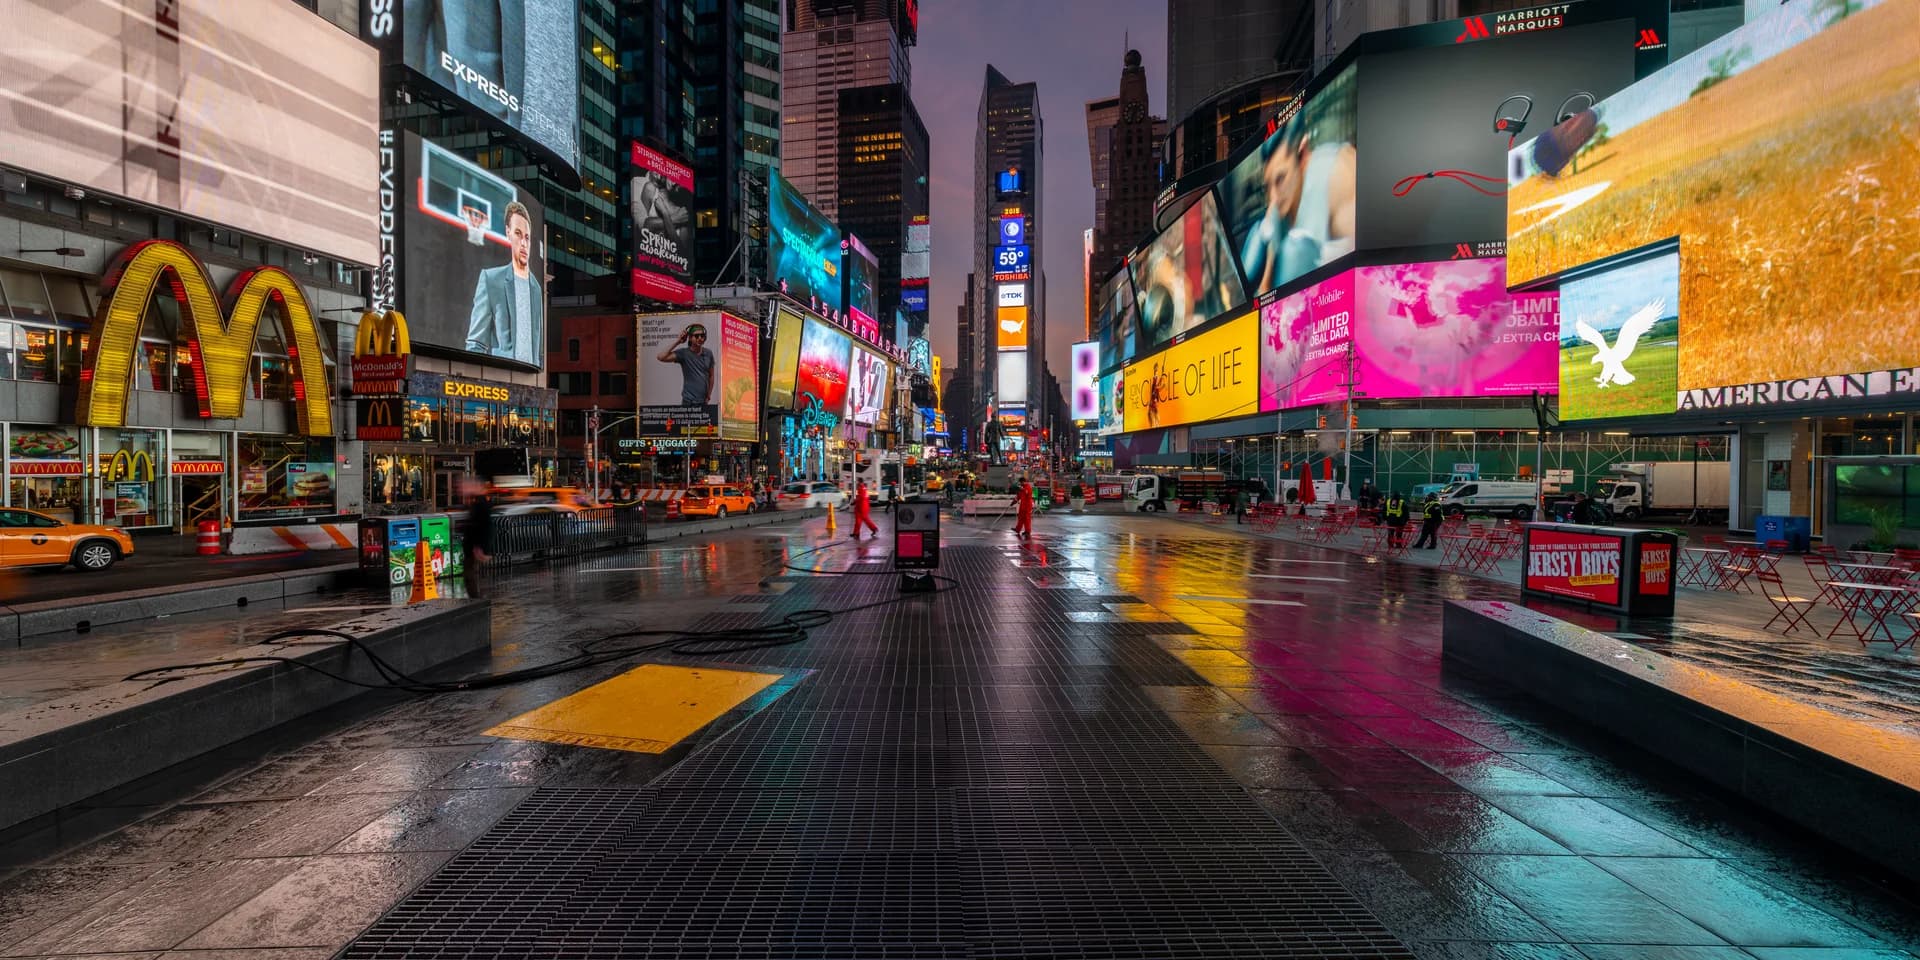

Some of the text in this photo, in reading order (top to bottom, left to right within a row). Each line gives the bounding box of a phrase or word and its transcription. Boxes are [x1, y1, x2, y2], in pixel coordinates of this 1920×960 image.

[1496, 5, 1570, 24] MARRIOTT
[1496, 17, 1562, 35] MARQUIS
[1639, 43, 1667, 51] MARRIOTT
[441, 51, 519, 113] EXPRESS
[641, 228, 677, 254] SPRING
[640, 242, 689, 271] awakening
[840, 247, 850, 255] LG
[999, 251, 1024, 266] 59°
[995, 273, 1029, 281] TOSHIBA
[1330, 326, 1350, 340] DATA
[353, 362, 403, 374] McDonald's
[1185, 359, 1205, 398] OF
[1212, 347, 1242, 394] LIFE
[445, 381, 509, 402] EXPRESS
[1680, 371, 1874, 411] AMERICAN
[1528, 550, 1620, 578] JERSEY BOYS
[1641, 549, 1671, 564] JERSEY
[1646, 570, 1666, 584] BOYS
